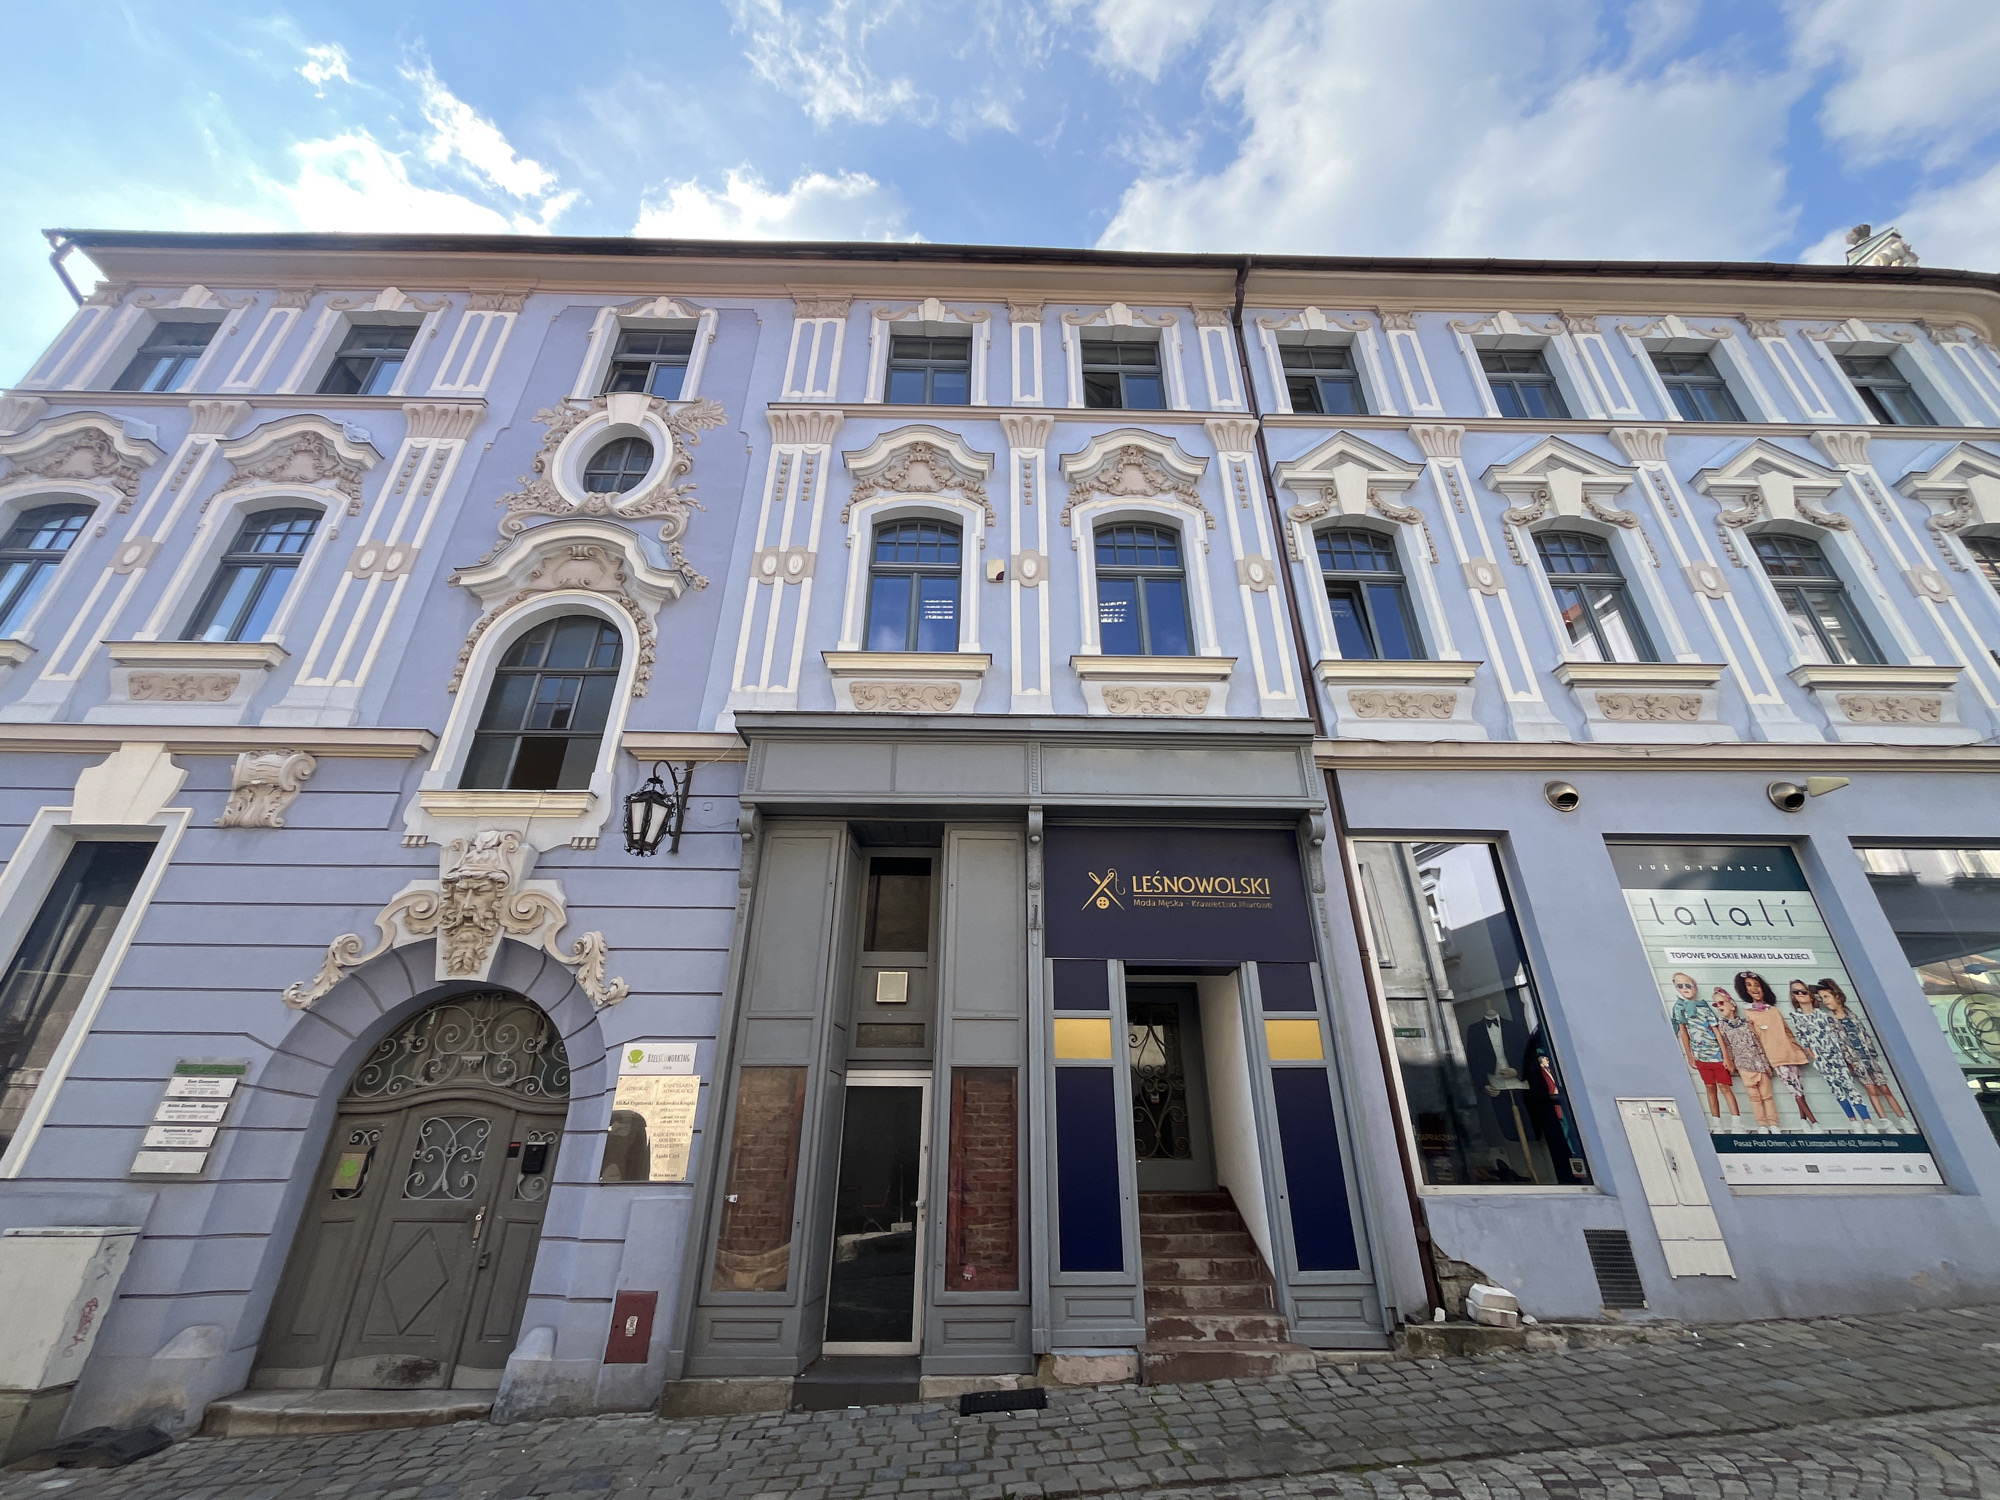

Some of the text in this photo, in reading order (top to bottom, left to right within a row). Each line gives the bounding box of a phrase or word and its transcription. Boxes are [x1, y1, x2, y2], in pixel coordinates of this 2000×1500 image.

[1131, 870, 1271, 895] LEŚNOWOLSKI
[1133, 898, 1156, 907] Moda
[1157, 899, 1184, 909] Męska
[1670, 951, 1810, 961] TOPOWE POLSKIE MARKI DLA DZIECI
[1753, 1139, 1767, 1147] Pod
